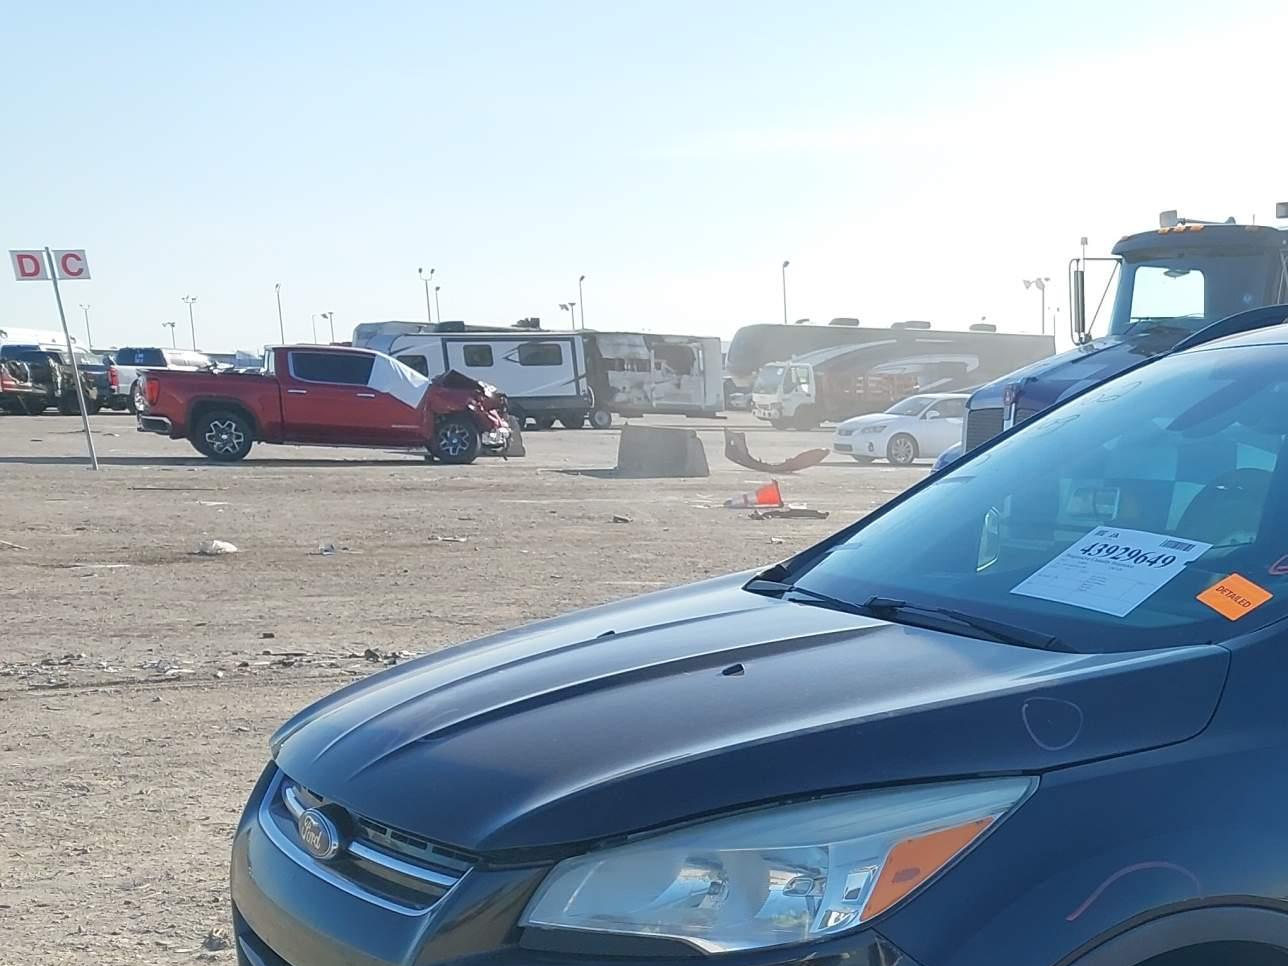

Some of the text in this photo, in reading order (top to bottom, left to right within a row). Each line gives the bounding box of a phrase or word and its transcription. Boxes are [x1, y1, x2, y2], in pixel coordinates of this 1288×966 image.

[16, 254, 40, 277] D
[61, 253, 84, 277] C
[1078, 542, 1177, 569] 43929649
[1215, 585, 1252, 608] DETAILED
